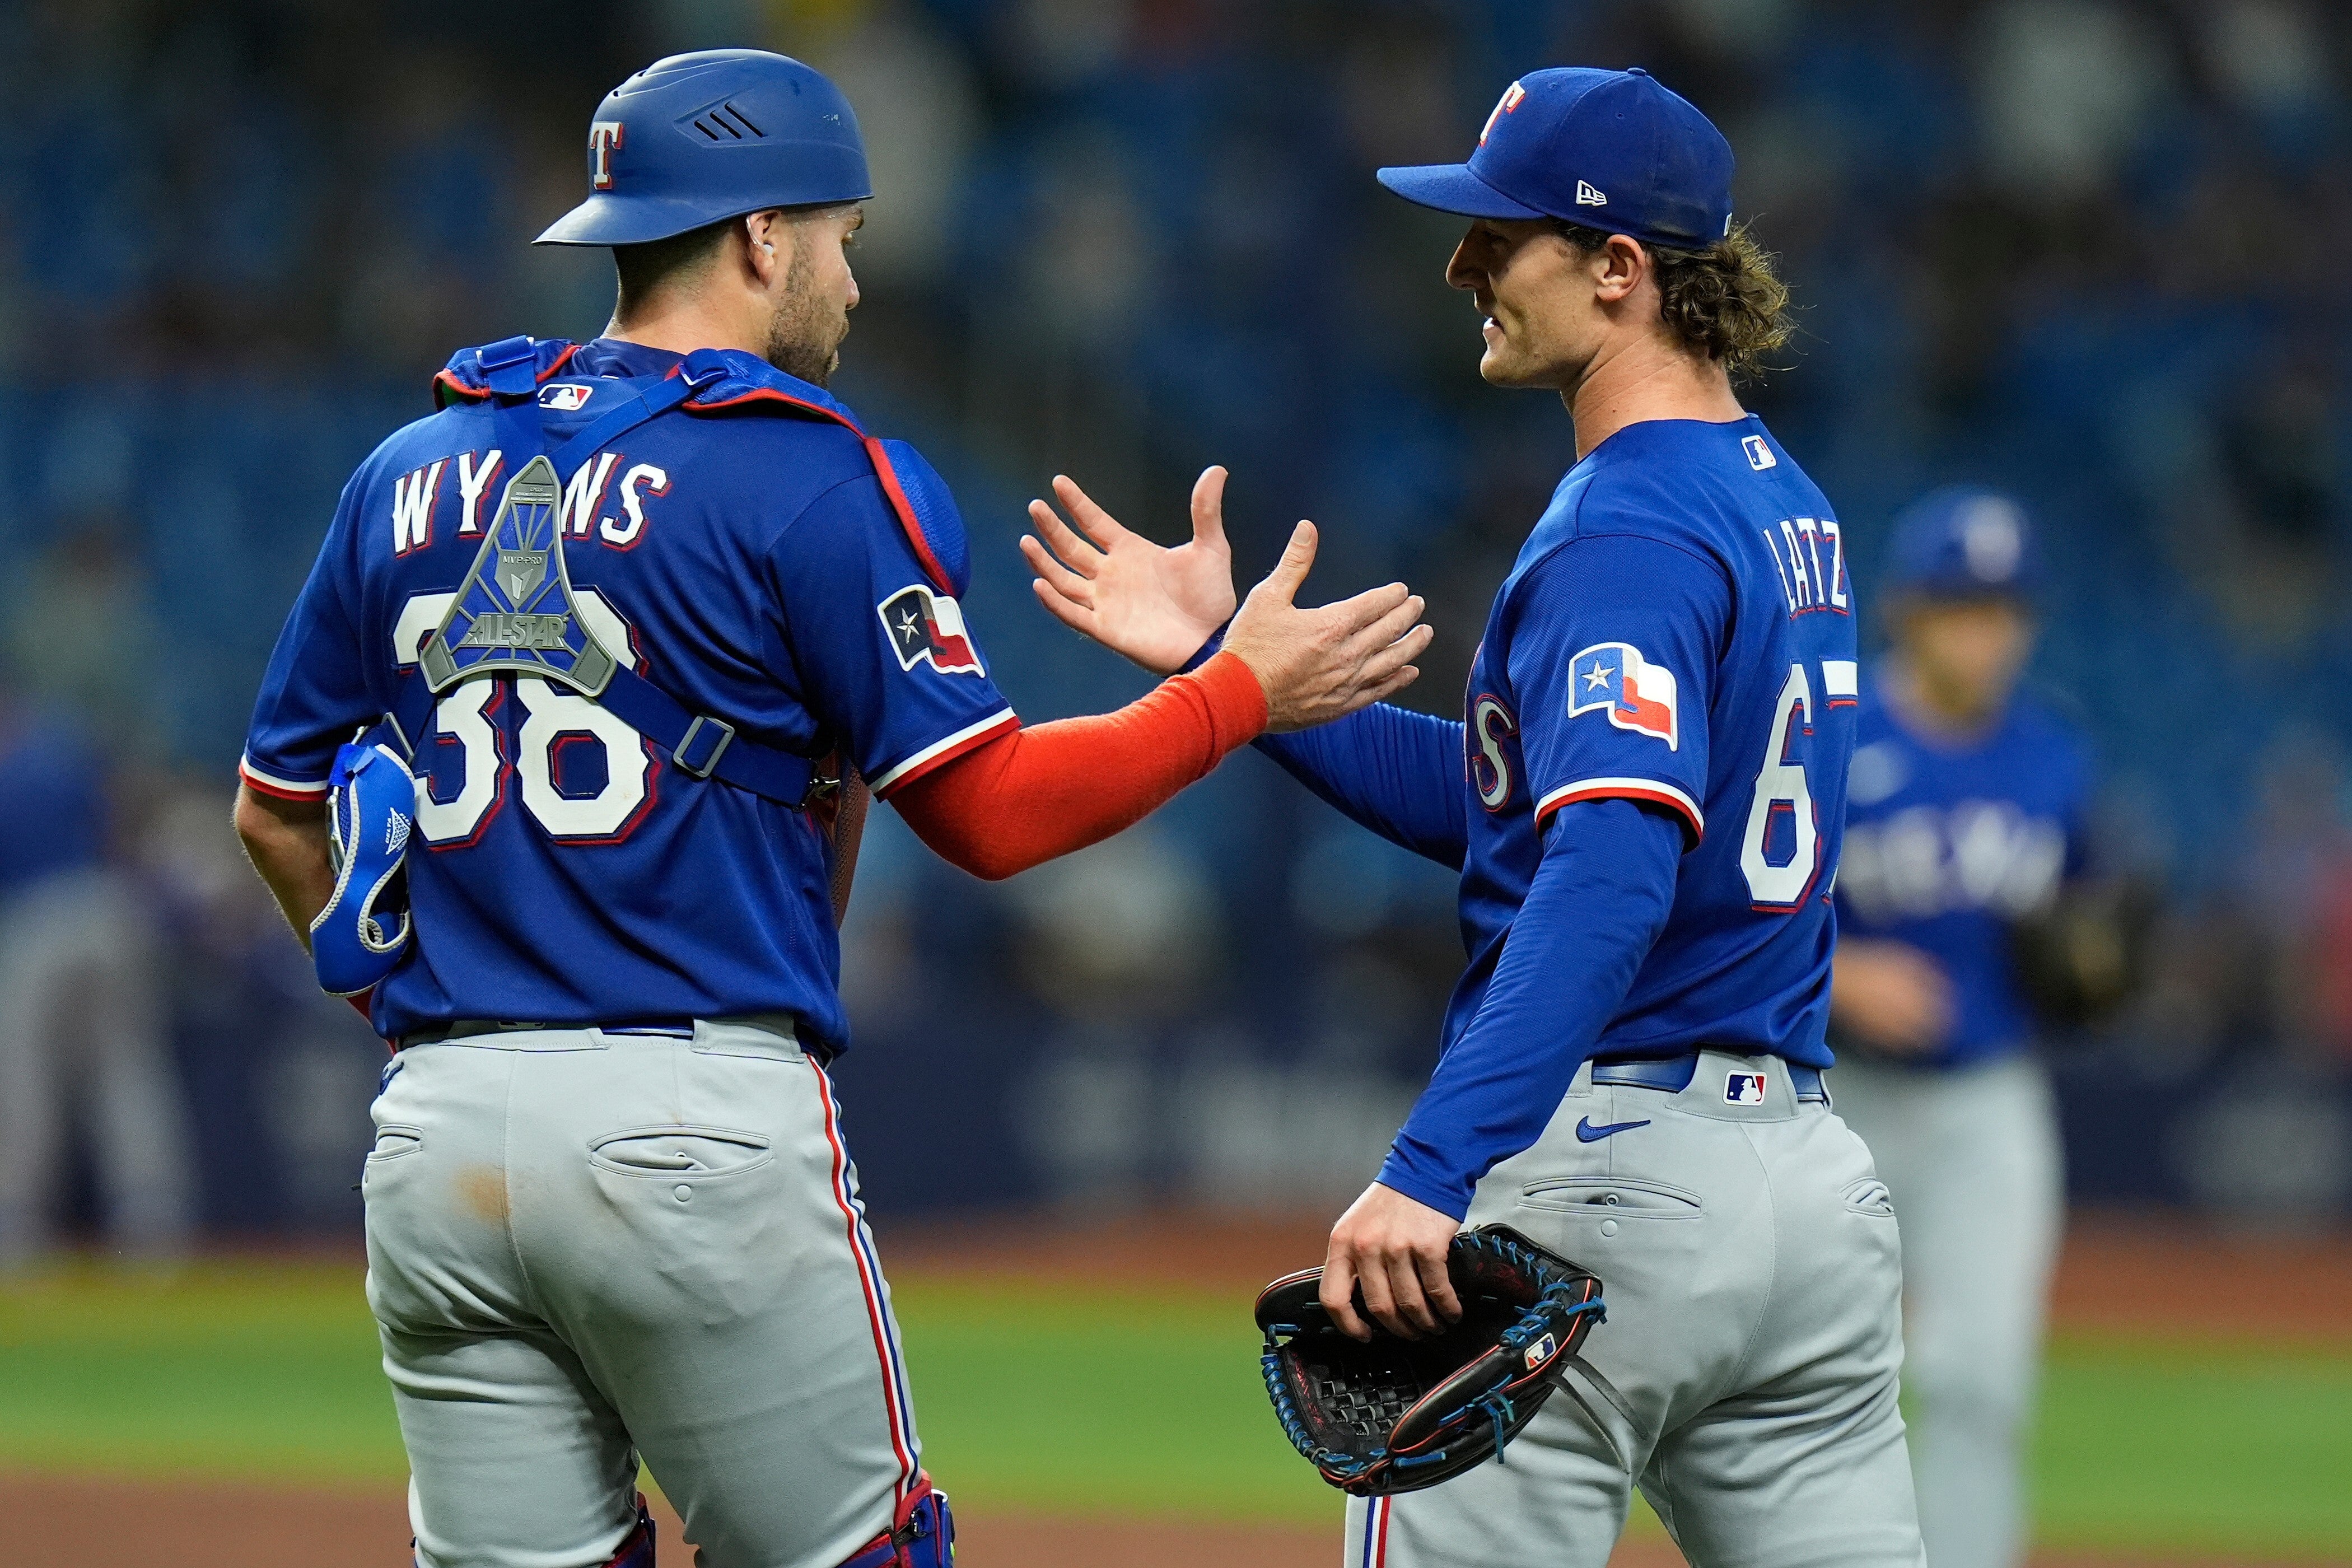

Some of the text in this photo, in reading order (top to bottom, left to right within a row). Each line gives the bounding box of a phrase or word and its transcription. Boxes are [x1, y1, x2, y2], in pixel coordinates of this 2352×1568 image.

[589, 121, 623, 190] T
[1480, 80, 1525, 147] T
[392, 448, 671, 559] WYNS
[392, 585, 664, 852] 38
